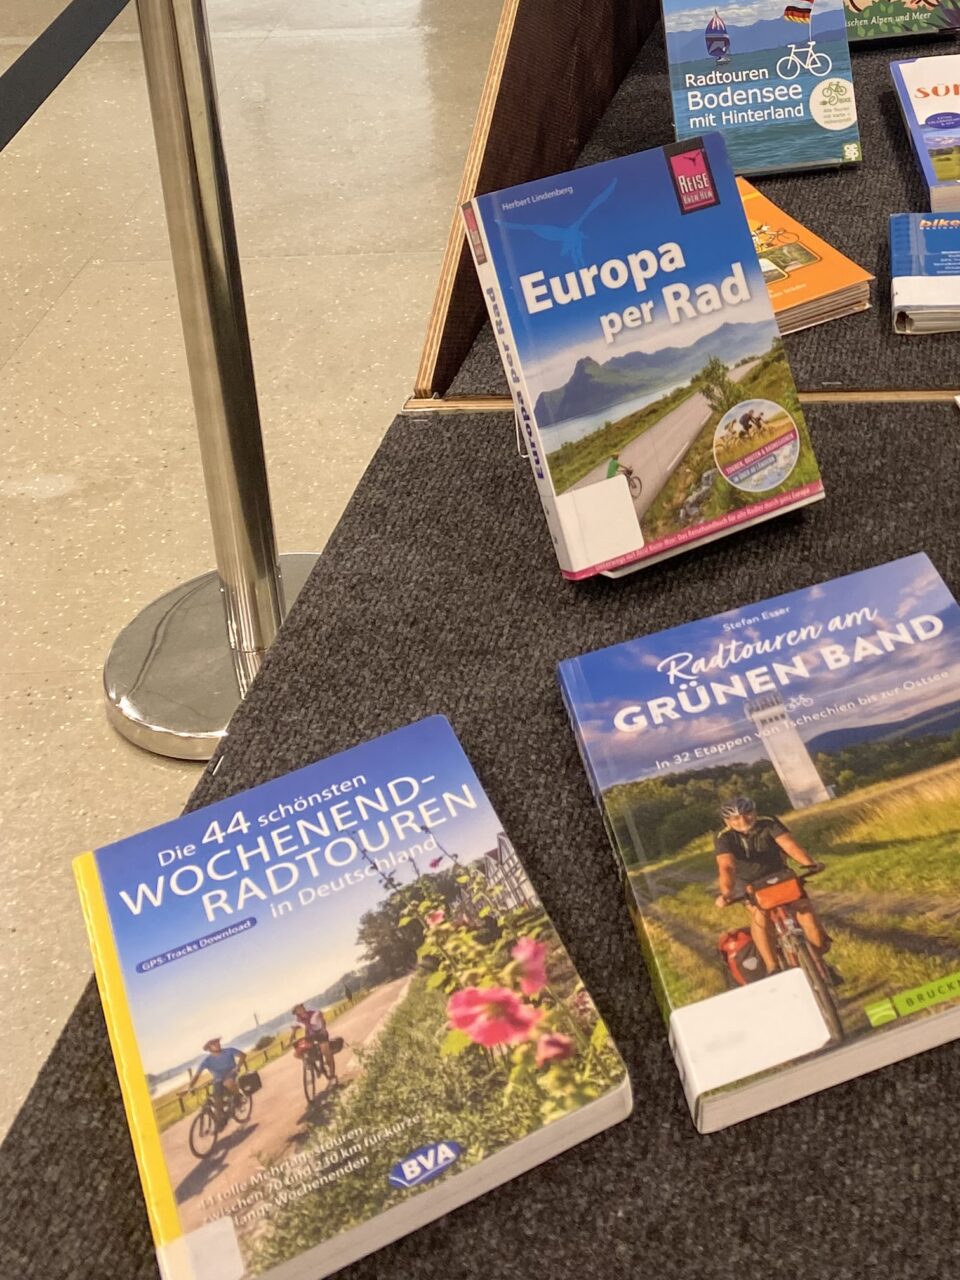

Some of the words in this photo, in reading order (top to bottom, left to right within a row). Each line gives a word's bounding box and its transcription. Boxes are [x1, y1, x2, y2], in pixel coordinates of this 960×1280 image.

[871, 16, 893, 26] Alpen
[895, 13, 910, 22] und
[912, 12, 931, 20] Meer
[685, 67, 769, 88] Radtouren
[687, 83, 803, 111] Bodensee
[690, 111, 717, 129] mit
[721, 103, 804, 126] Hinterland
[502, 197, 531, 211] Herbert
[531, 185, 574, 204] Lindenberg
[678, 173, 709, 193] REISE
[520, 240, 686, 315] Europa
[600, 299, 654, 343] per
[662, 262, 752, 323] Rad
[486, 287, 505, 335] Rad
[503, 341, 519, 384] per
[516, 389, 545, 480] Europa
[723, 616, 760, 633] Stefan
[761, 605, 792, 621] Esser
[656, 622, 824, 684] Radtouren
[827, 607, 879, 632] am
[613, 656, 814, 734] GRÜNEN
[820, 614, 944, 670] BAND
[656, 760, 670, 771] In
[673, 752, 691, 764] 32
[694, 736, 752, 759] Etappen
[754, 725, 780, 738] von
[783, 700, 856, 730] Tschechien
[858, 693, 878, 707] bis
[880, 687, 901, 700] zur
[903, 671, 949, 693] Ostsee
[119, 775, 436, 916] WOCHENEND-
[157, 842, 196, 867] Die
[201, 810, 251, 845] 44
[257, 774, 367, 828] schönsten
[201, 784, 479, 922] RADTOUREN
[270, 899, 293, 919] in
[298, 835, 438, 907] Deutschland
[141, 941, 198, 972] GPS-Tracks
[199, 920, 252, 950] Download
[216, 1183, 247, 1203] tolle
[250, 1126, 364, 1185] Mehrtagestouren
[339, 1141, 363, 1160] km
[364, 1133, 381, 1150] für
[402, 1142, 457, 1181] BVA
[274, 1155, 370, 1207] Wochenenden
